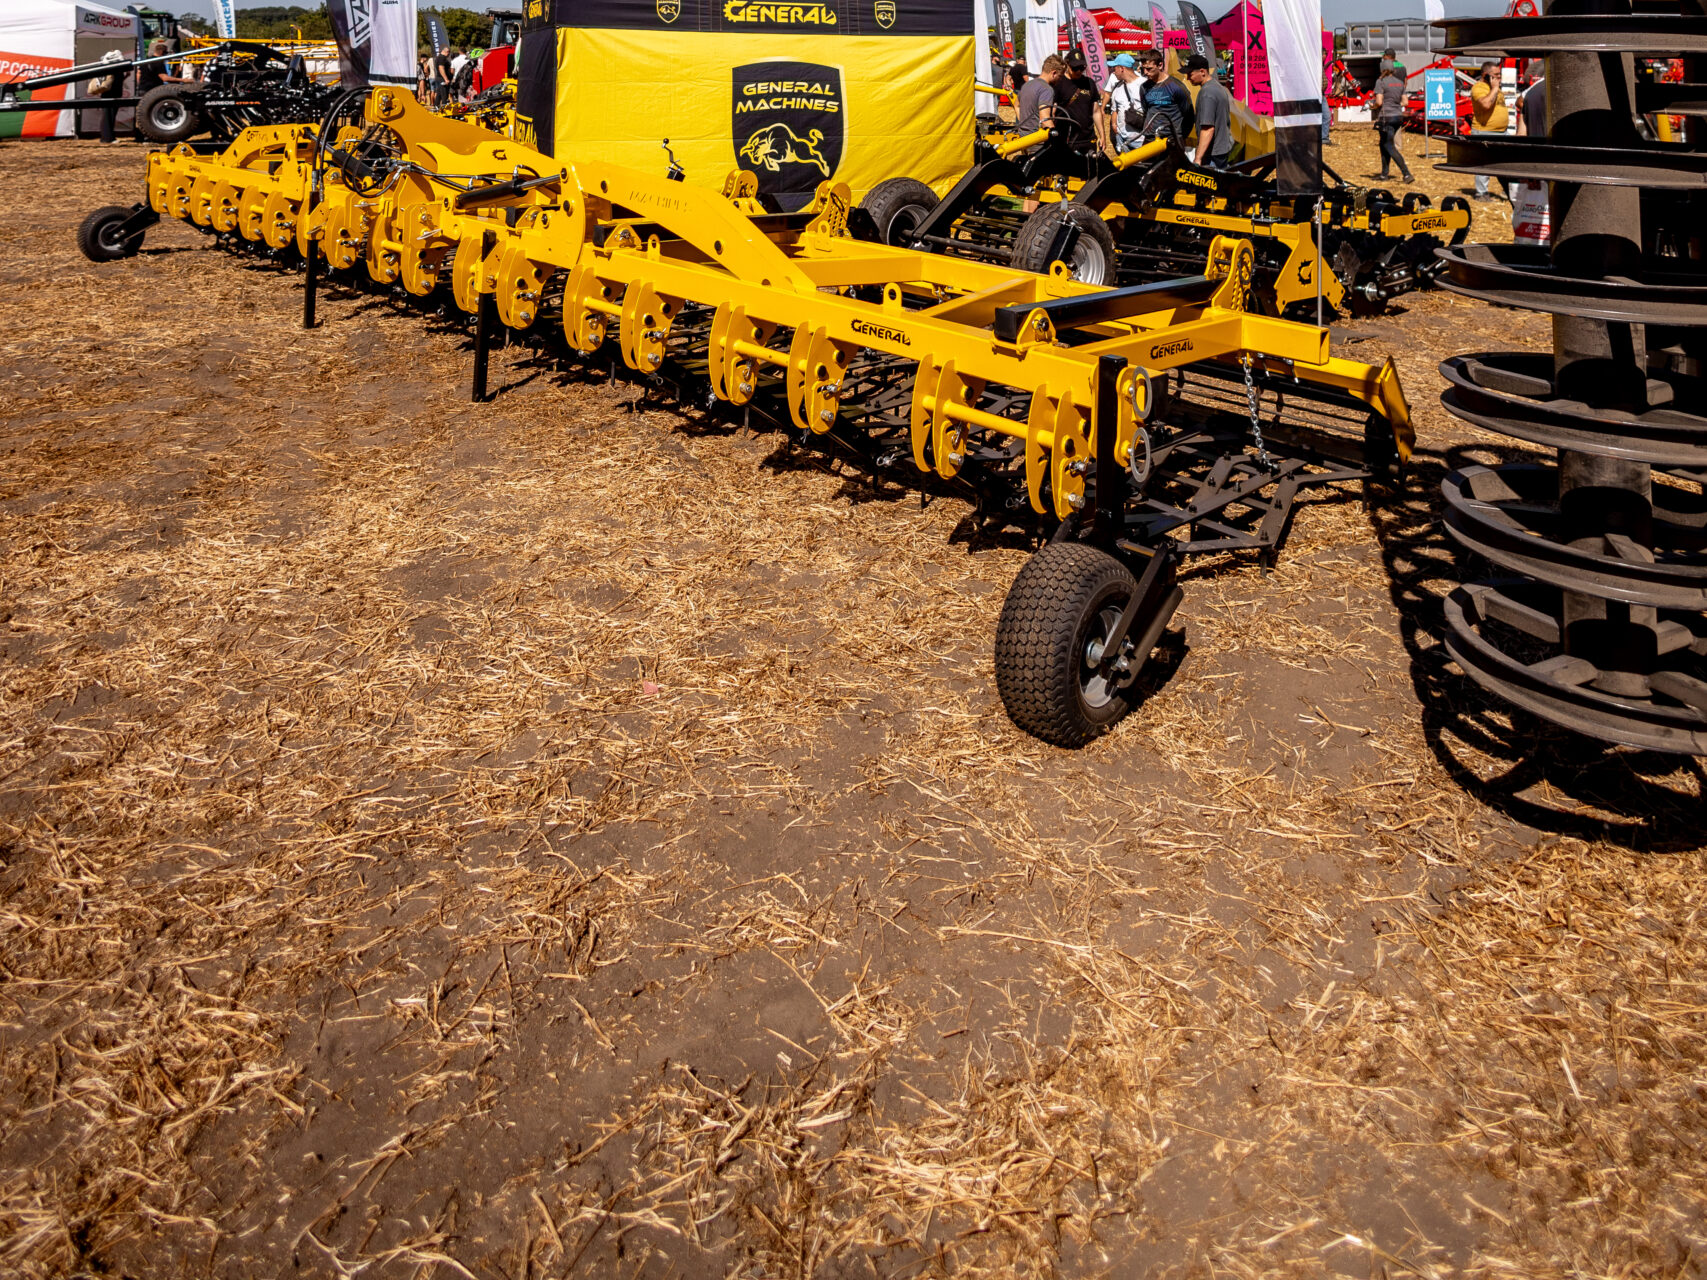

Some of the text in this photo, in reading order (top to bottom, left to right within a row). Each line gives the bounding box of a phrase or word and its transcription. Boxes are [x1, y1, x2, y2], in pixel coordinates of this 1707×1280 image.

[743, 81, 836, 96] GENERAL
[735, 97, 840, 114] MACHINES
[1428, 109, 1454, 117] ПОКАЗ
[1430, 102, 1452, 110] ДЕМО
[1175, 168, 1218, 191] GENERAL
[1176, 215, 1210, 225] GENERAL
[1411, 215, 1447, 231] GENERAL
[850, 318, 911, 346] GENERAL
[1150, 338, 1194, 360] GENERAL
